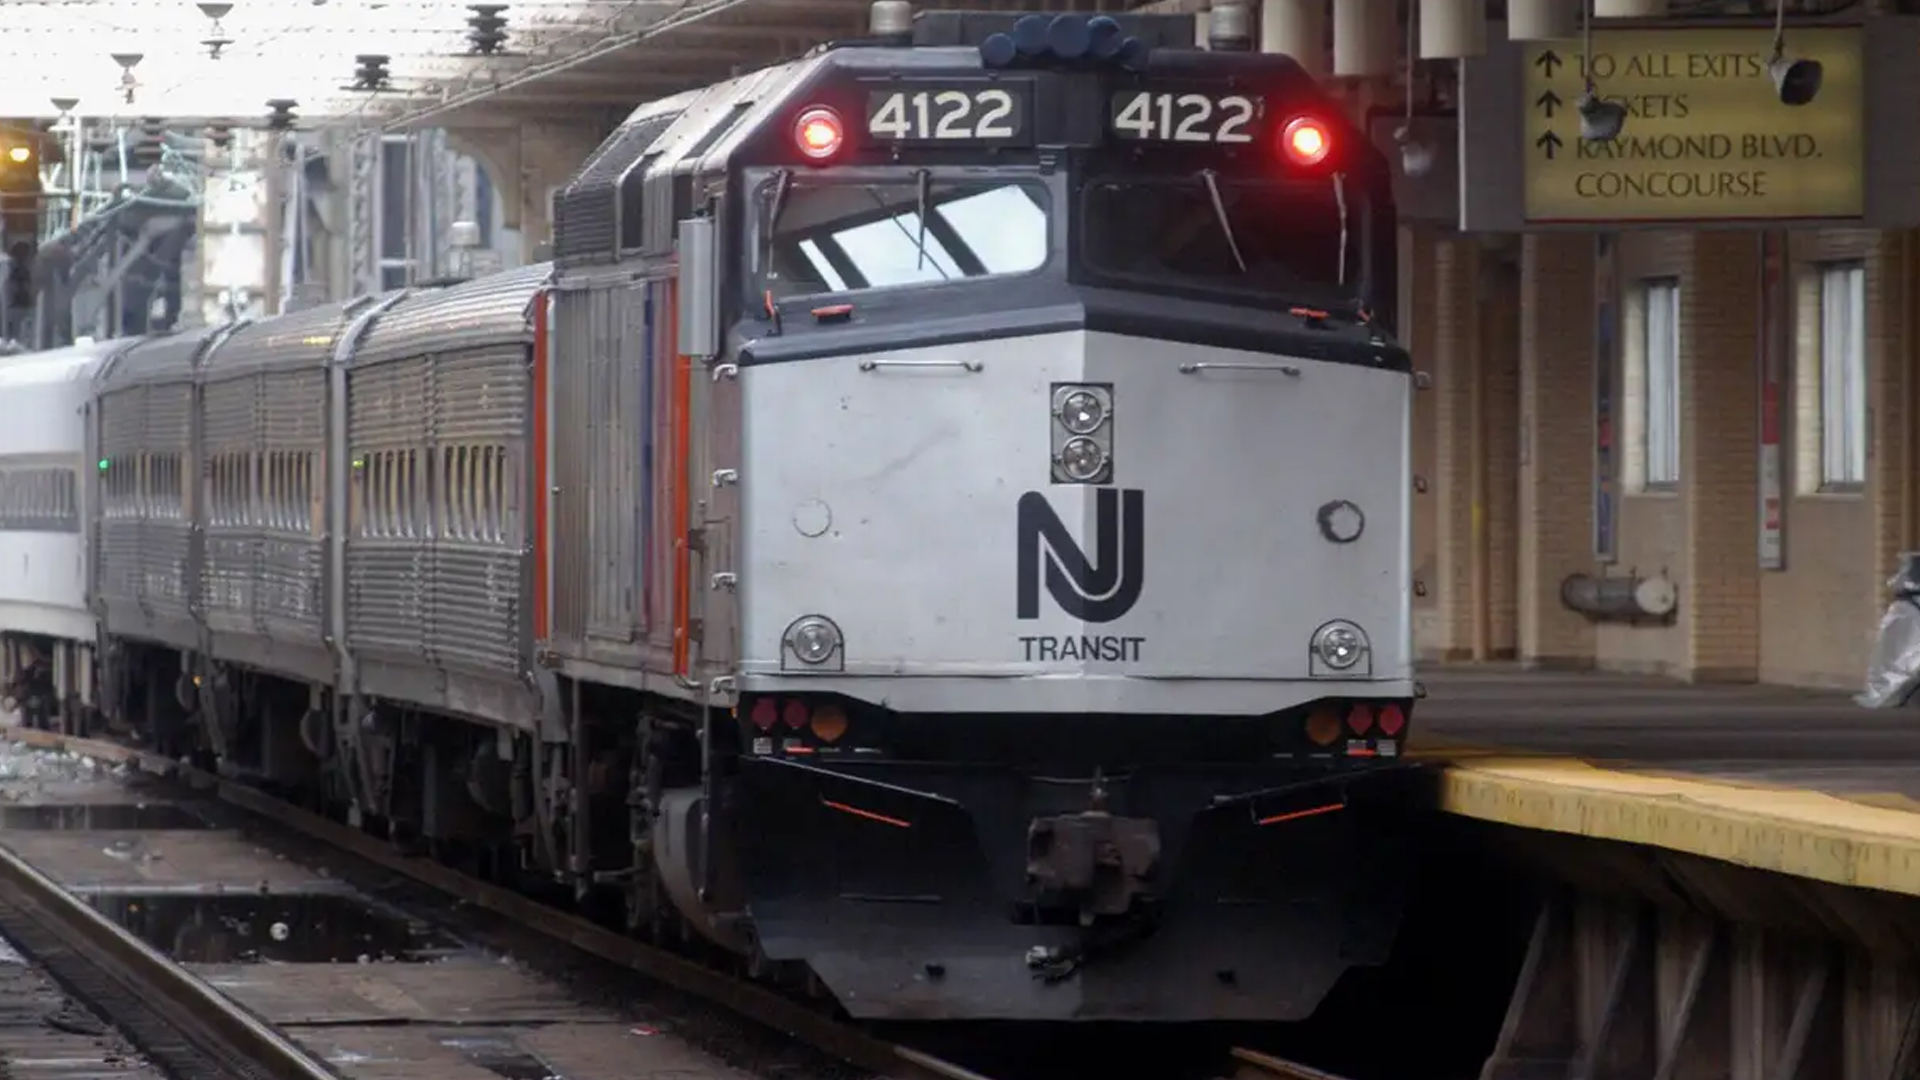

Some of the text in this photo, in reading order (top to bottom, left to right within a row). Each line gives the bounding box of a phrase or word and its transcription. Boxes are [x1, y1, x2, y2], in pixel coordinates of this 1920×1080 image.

[1574, 54, 1761, 78] TO ALL EXITS
[869, 89, 1013, 139] 4122
[1115, 92, 1254, 142] 4122
[1576, 133, 1823, 159] RAYMOND BLVD.
[1575, 171, 1767, 197] CONCOURSE
[1019, 636, 1146, 662] TRANSIT
